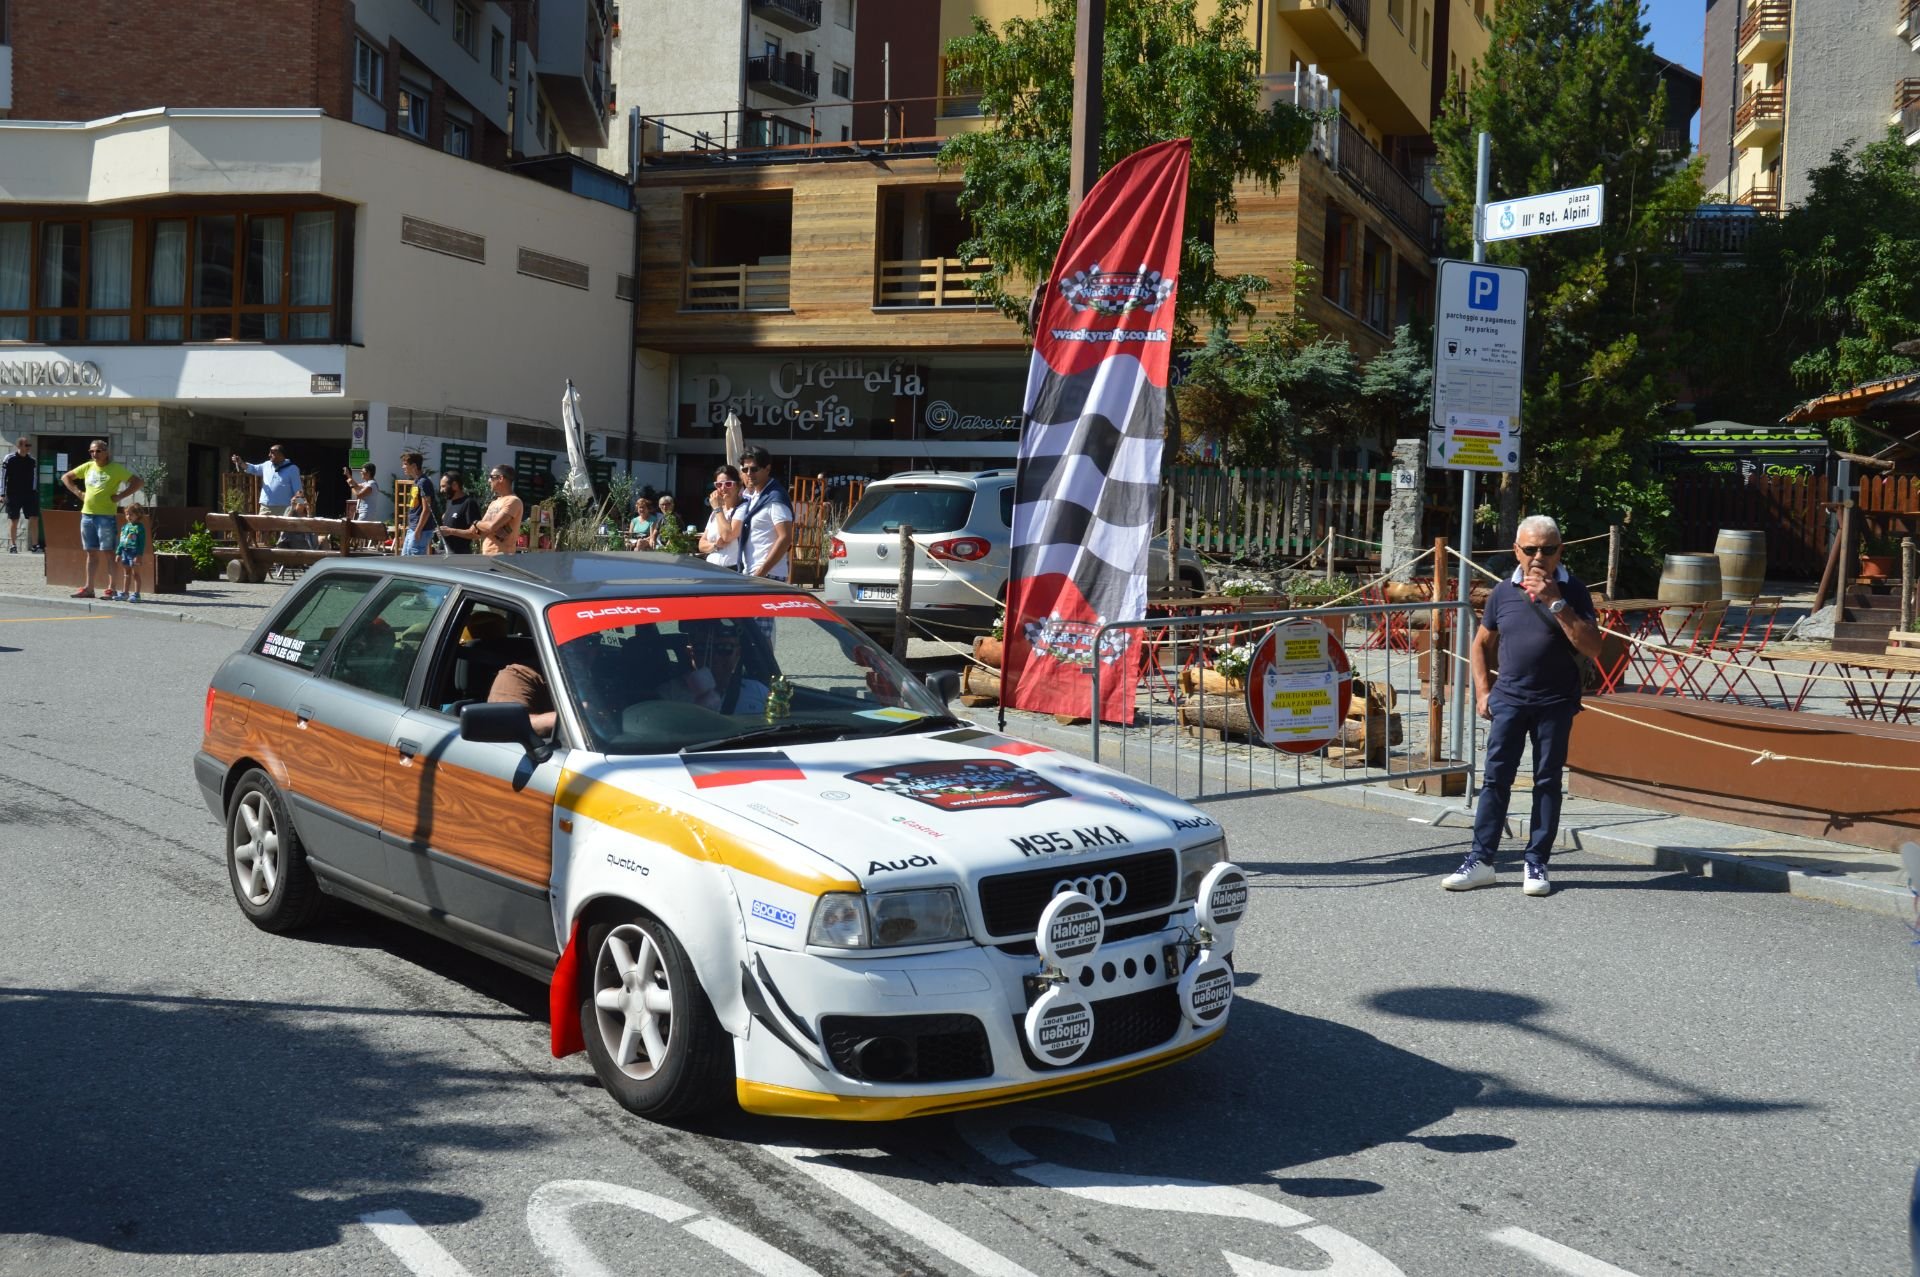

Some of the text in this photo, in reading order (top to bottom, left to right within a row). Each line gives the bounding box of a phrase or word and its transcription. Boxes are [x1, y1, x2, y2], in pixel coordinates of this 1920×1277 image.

[1568, 194, 1590, 205] piazza
[1538, 211, 1558, 226] Rgt.
[1563, 205, 1590, 222] Alpini
[1080, 285, 1152, 299] Wacky Rally
[1475, 276, 1493, 305] P
[1485, 316, 1517, 326] pagamento
[1052, 327, 1168, 343] wackyrally.co.uk
[1464, 325, 1499, 336] pay parking
[769, 356, 925, 400] Cremeria
[690, 373, 854, 433] Pasticceria
[1400, 474, 1412, 484] 29
[576, 606, 662, 619] quattro
[761, 600, 820, 611] quattro
[276, 647, 288, 659] LEE
[291, 639, 306, 651] FAST
[902, 819, 945, 838] Castrol
[1171, 816, 1216, 831] Audi
[1009, 825, 1131, 857] M95 AKA
[606, 853, 650, 877] quattro
[868, 855, 938, 876] Audi
[1212, 889, 1246, 906] Halogen
[753, 901, 796, 923] sparco
[1214, 905, 1244, 915] SUPER SPORT
[1052, 920, 1098, 940] Halogen
[1055, 935, 1097, 950] SUPER SPORT
[1194, 984, 1231, 1004] Halogen
[1043, 1012, 1086, 1026] SUPER SPORT
[1042, 1021, 1089, 1042] Halogen
